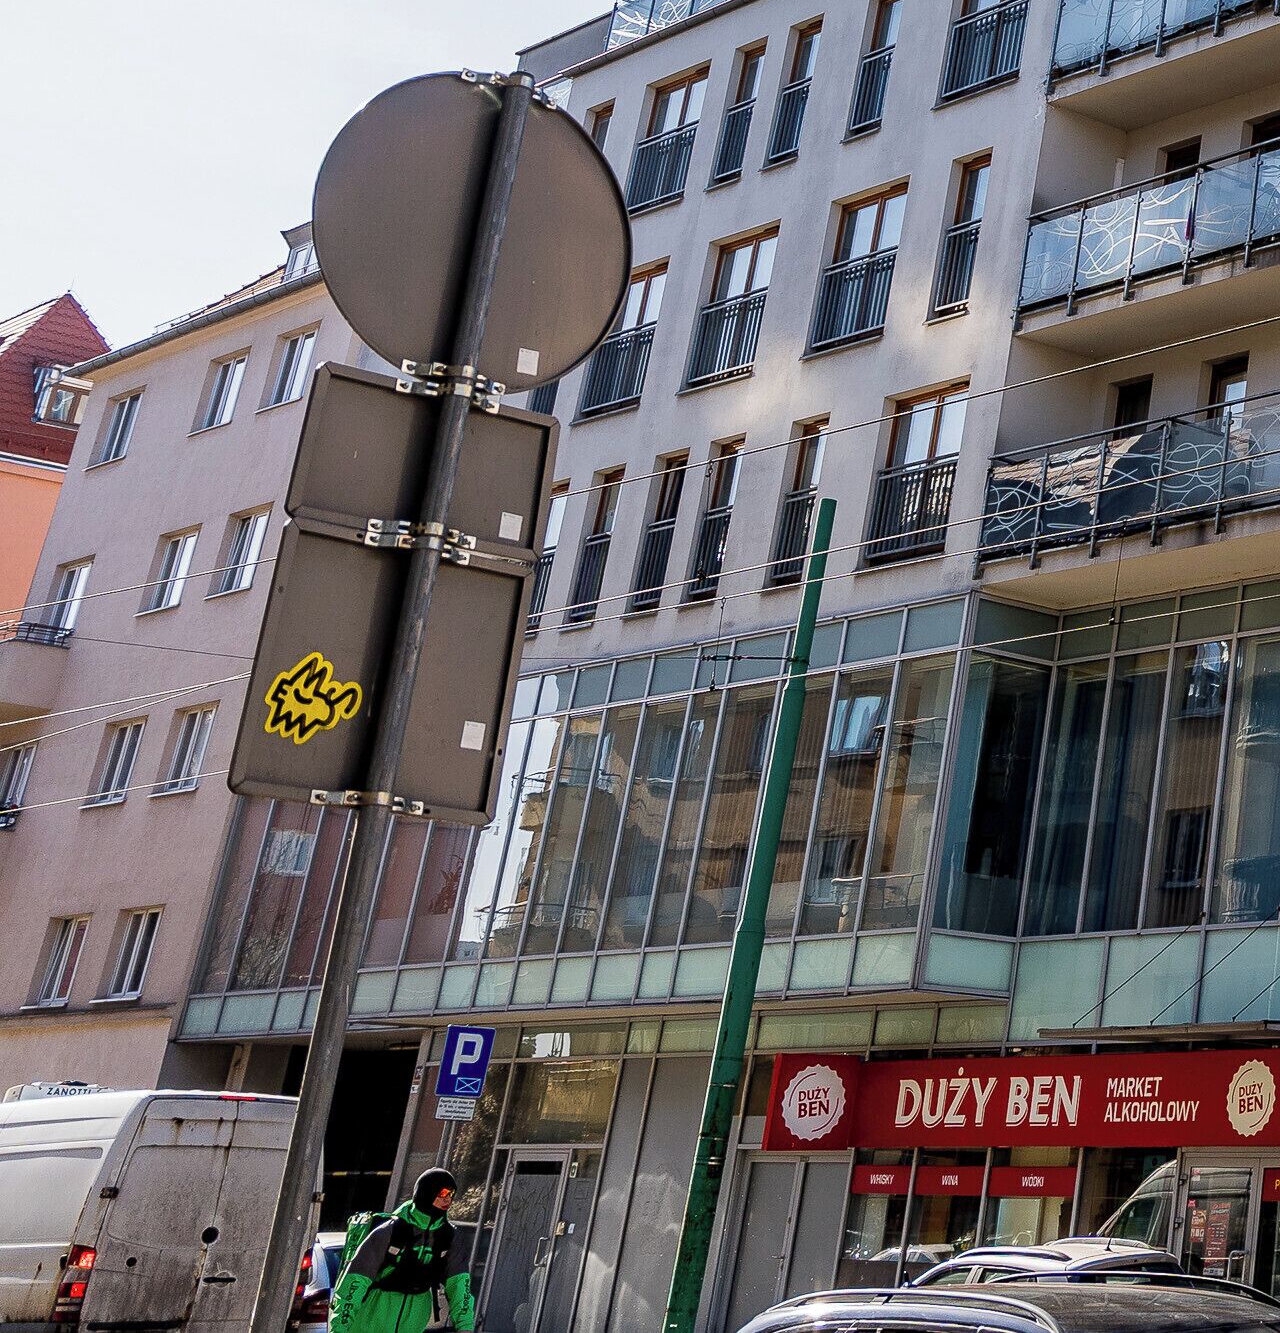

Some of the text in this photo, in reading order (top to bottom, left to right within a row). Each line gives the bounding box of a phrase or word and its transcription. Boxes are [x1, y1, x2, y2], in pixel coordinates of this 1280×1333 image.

[451, 1033, 483, 1075] P
[47, 1087, 91, 1096] ZANOTTI
[799, 1086, 830, 1103] DUŻY
[1106, 1076, 1163, 1098] MARKET
[1238, 1081, 1263, 1098] DUŻY
[895, 1066, 1083, 1129] DUŻY BEN
[1238, 1096, 1263, 1114] BEN
[798, 1100, 829, 1119] BEN
[1104, 1100, 1200, 1122] ALKOHOLOWY
[870, 1173, 895, 1185] WHISKY
[941, 1175, 959, 1186] WINA
[1022, 1174, 1045, 1187] WÓDKI
